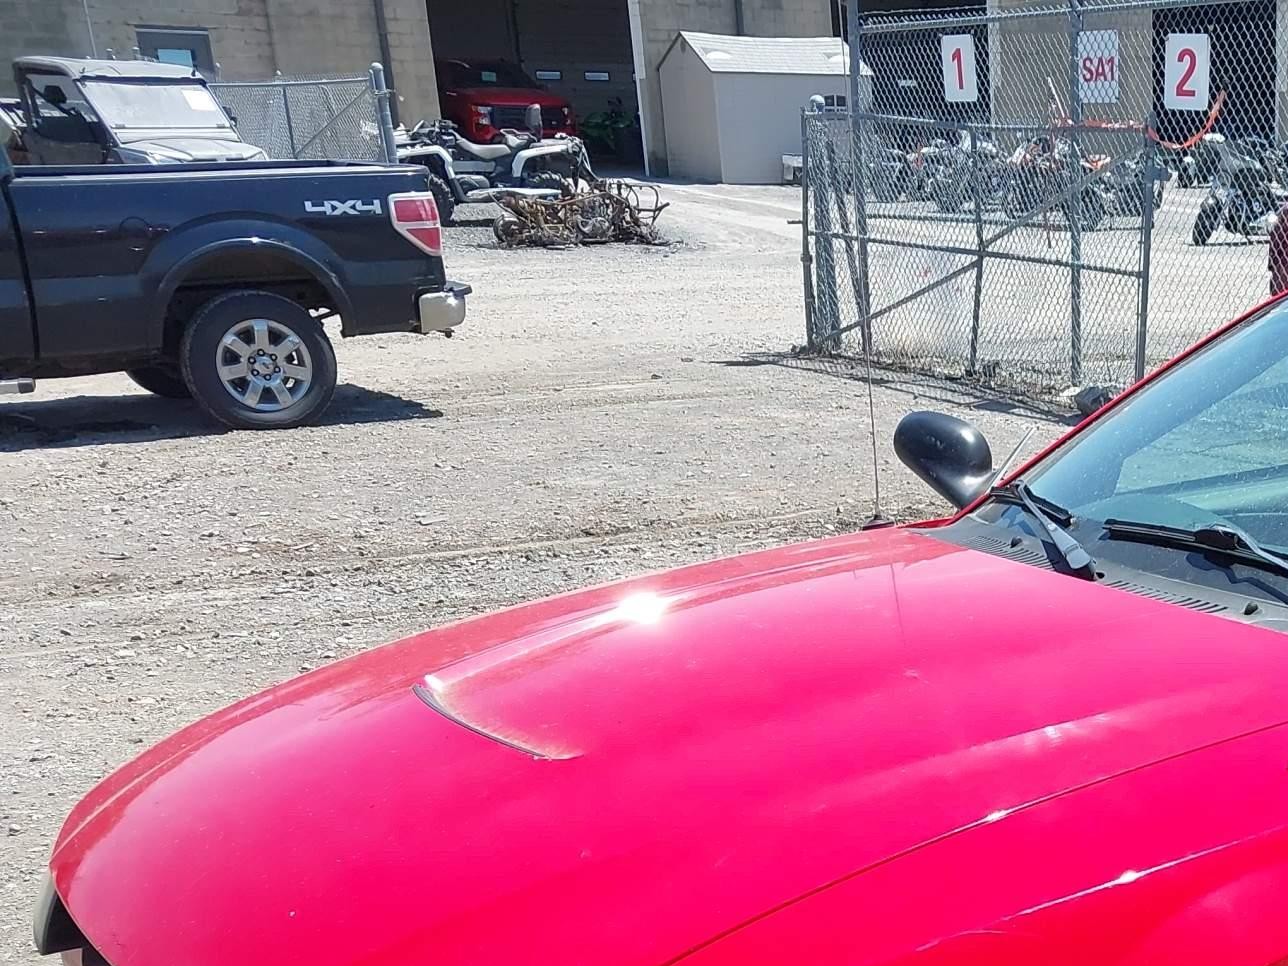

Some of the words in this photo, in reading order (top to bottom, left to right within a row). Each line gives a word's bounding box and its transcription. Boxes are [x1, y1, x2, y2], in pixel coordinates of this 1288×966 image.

[951, 47, 965, 90] 1
[1082, 57, 1115, 82] SA1
[1175, 48, 1197, 97] 2
